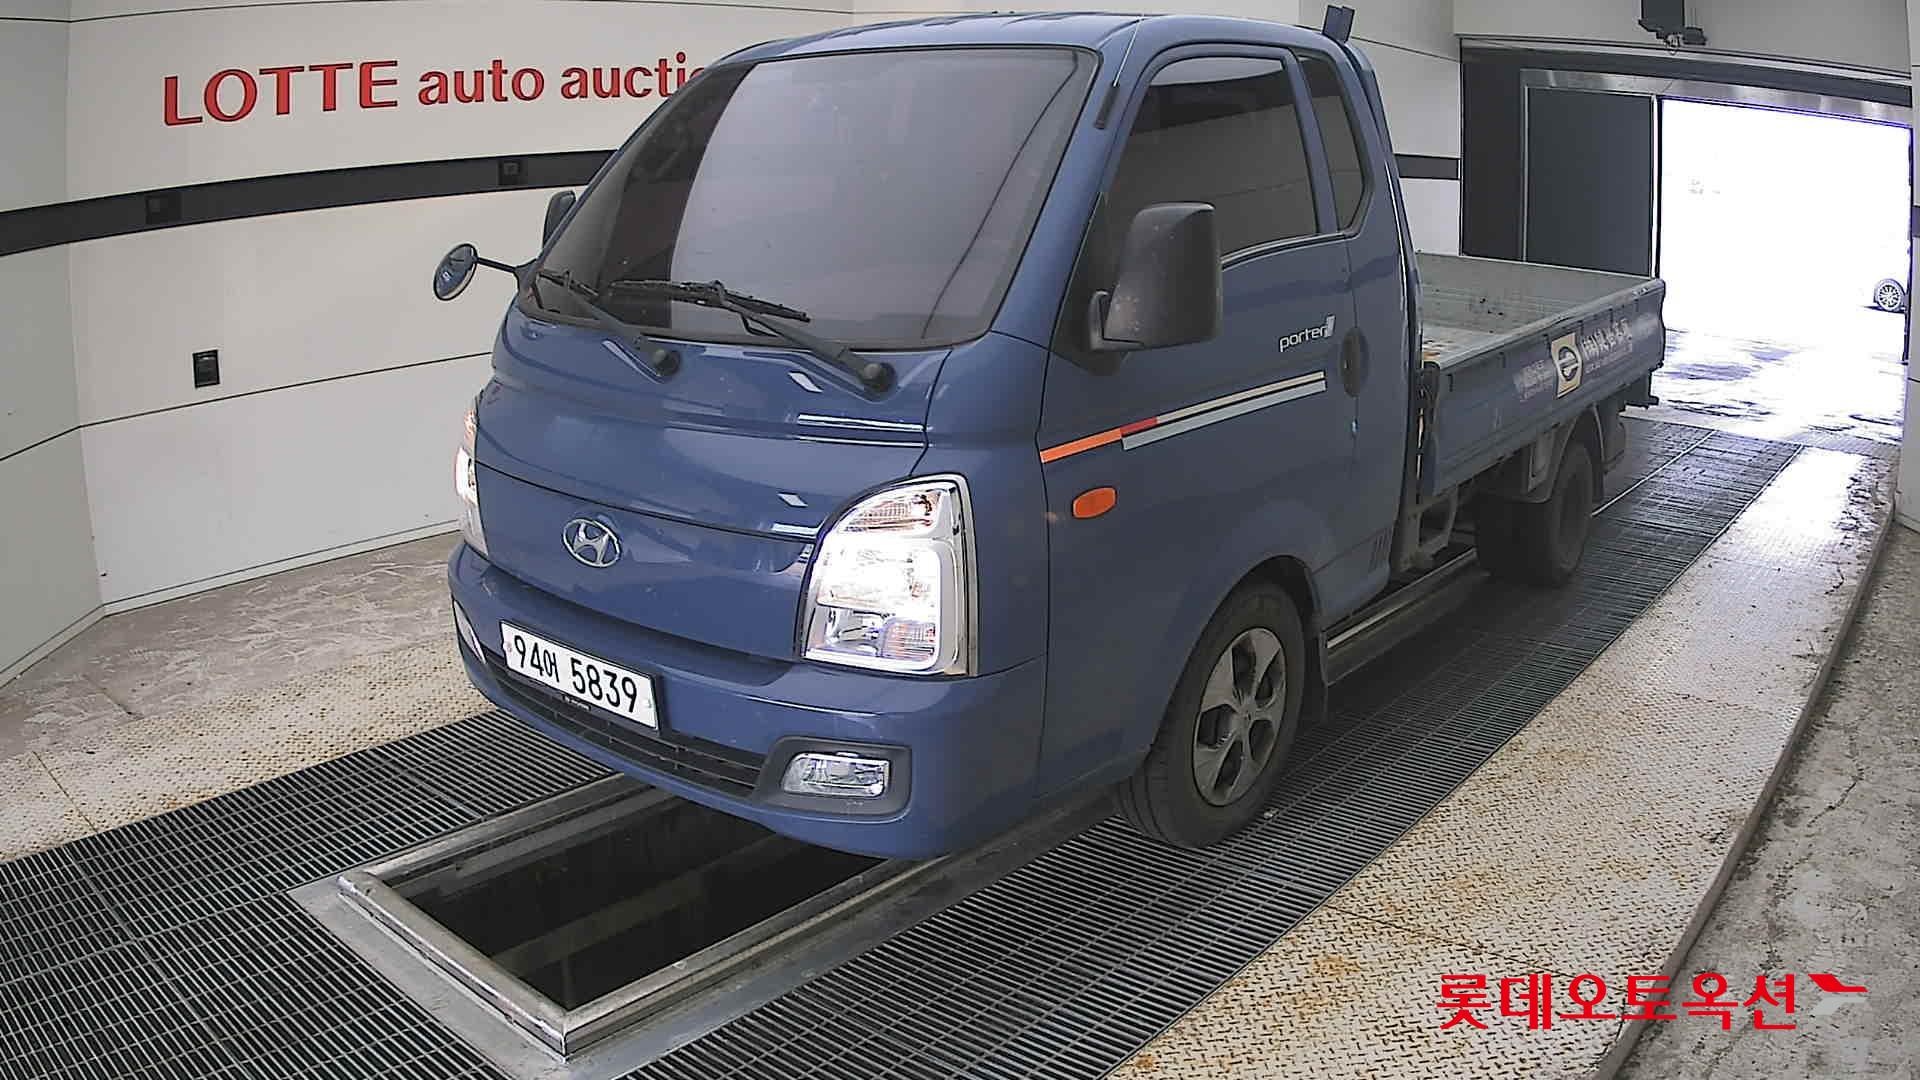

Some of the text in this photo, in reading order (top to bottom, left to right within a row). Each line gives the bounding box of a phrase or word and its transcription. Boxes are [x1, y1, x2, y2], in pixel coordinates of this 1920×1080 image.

[164, 51, 706, 126] LOTTE auto aucti
[514, 635, 638, 713] 94어 5839
